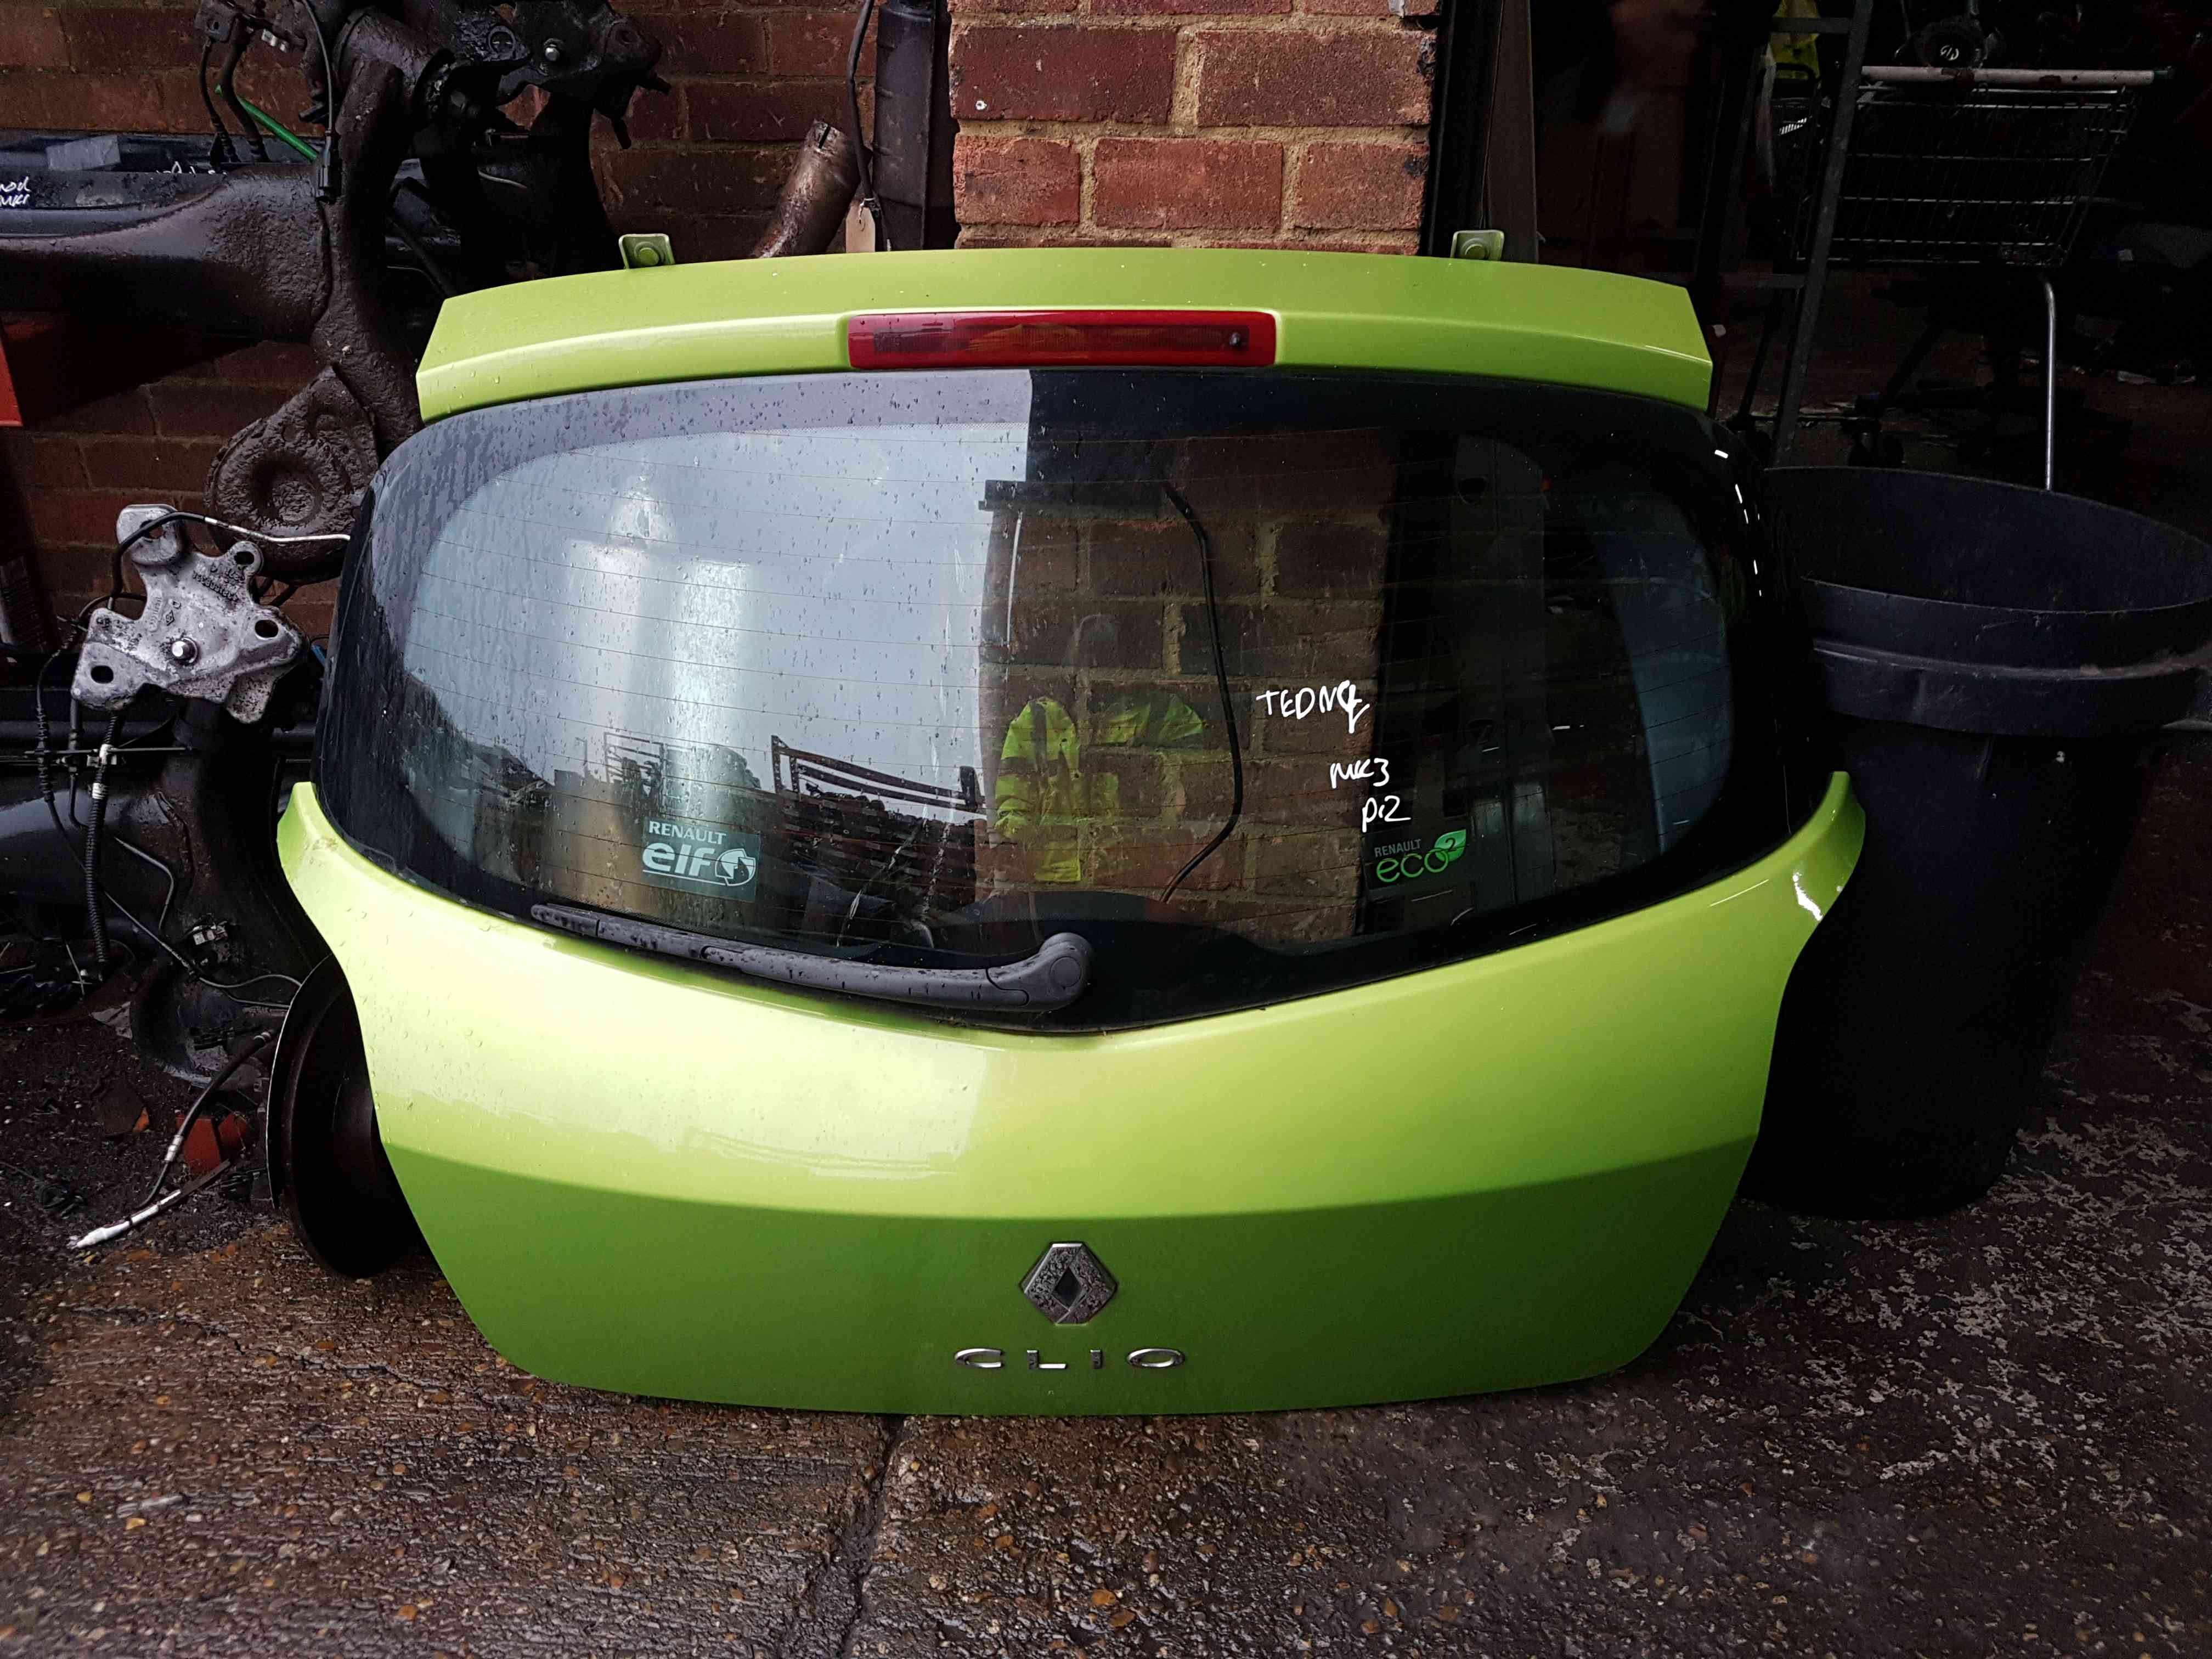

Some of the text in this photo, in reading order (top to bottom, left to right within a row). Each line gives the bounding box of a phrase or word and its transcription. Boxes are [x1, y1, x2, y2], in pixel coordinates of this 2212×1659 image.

[649, 820, 726, 845] RENAULT
[642, 842, 715, 877] elf
[1374, 838, 1421, 857] RENAULT
[955, 1347, 1186, 1370] CLIO
